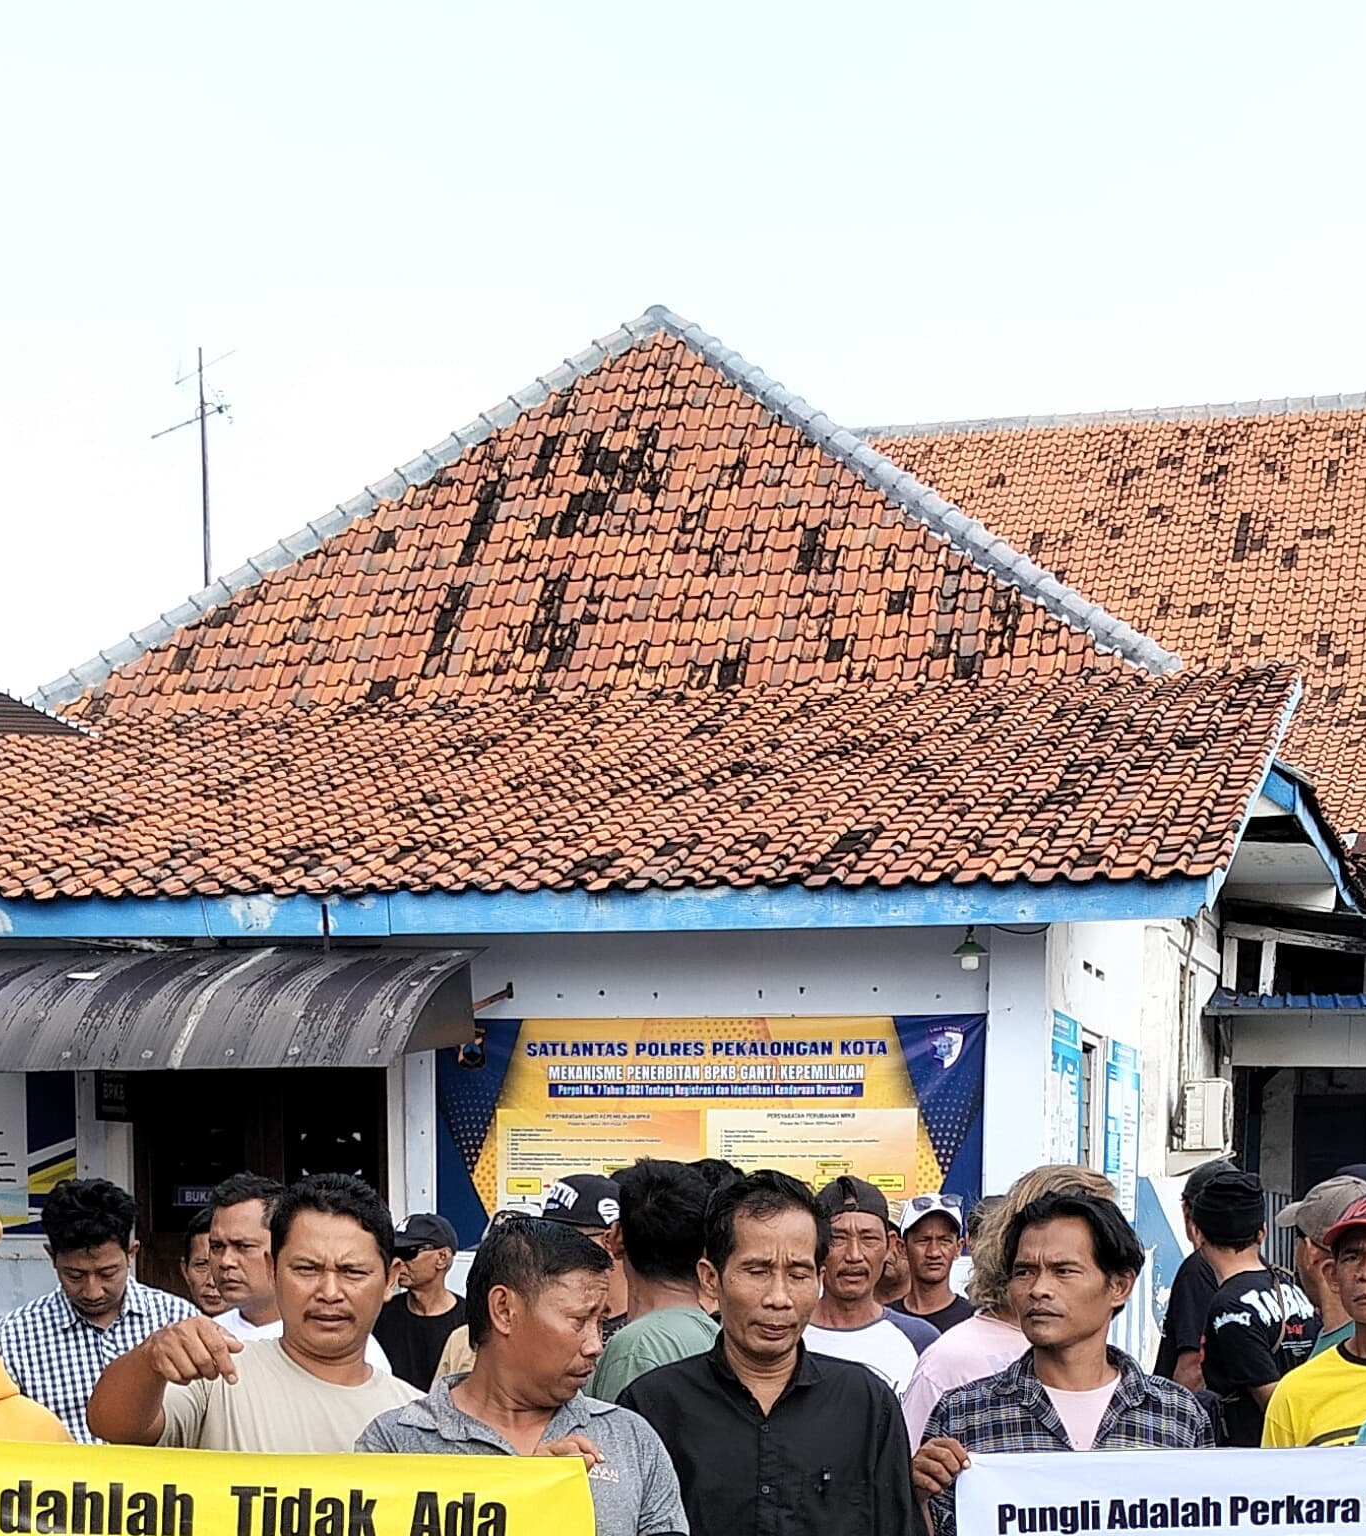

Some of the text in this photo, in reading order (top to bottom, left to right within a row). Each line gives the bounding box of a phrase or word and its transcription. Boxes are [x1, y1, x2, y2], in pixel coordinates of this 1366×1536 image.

[526, 1040, 889, 1057] SATLANTAS POLRES PEKALONGAN KOTA
[548, 1064, 865, 1081] MEKANISME PENERBITAN BPKB GANTI KEPEMILIKAN
[675, 1085, 714, 1097] Registrasi
[715, 1085, 730, 1095] dan
[774, 1084, 816, 1095] Kendaraan
[816, 1084, 854, 1095] Bermotor
[998, 1500, 1101, 1535] Pungli
[1106, 1496, 1222, 1530] Adalah
[1229, 1495, 1360, 1526] Perkara
